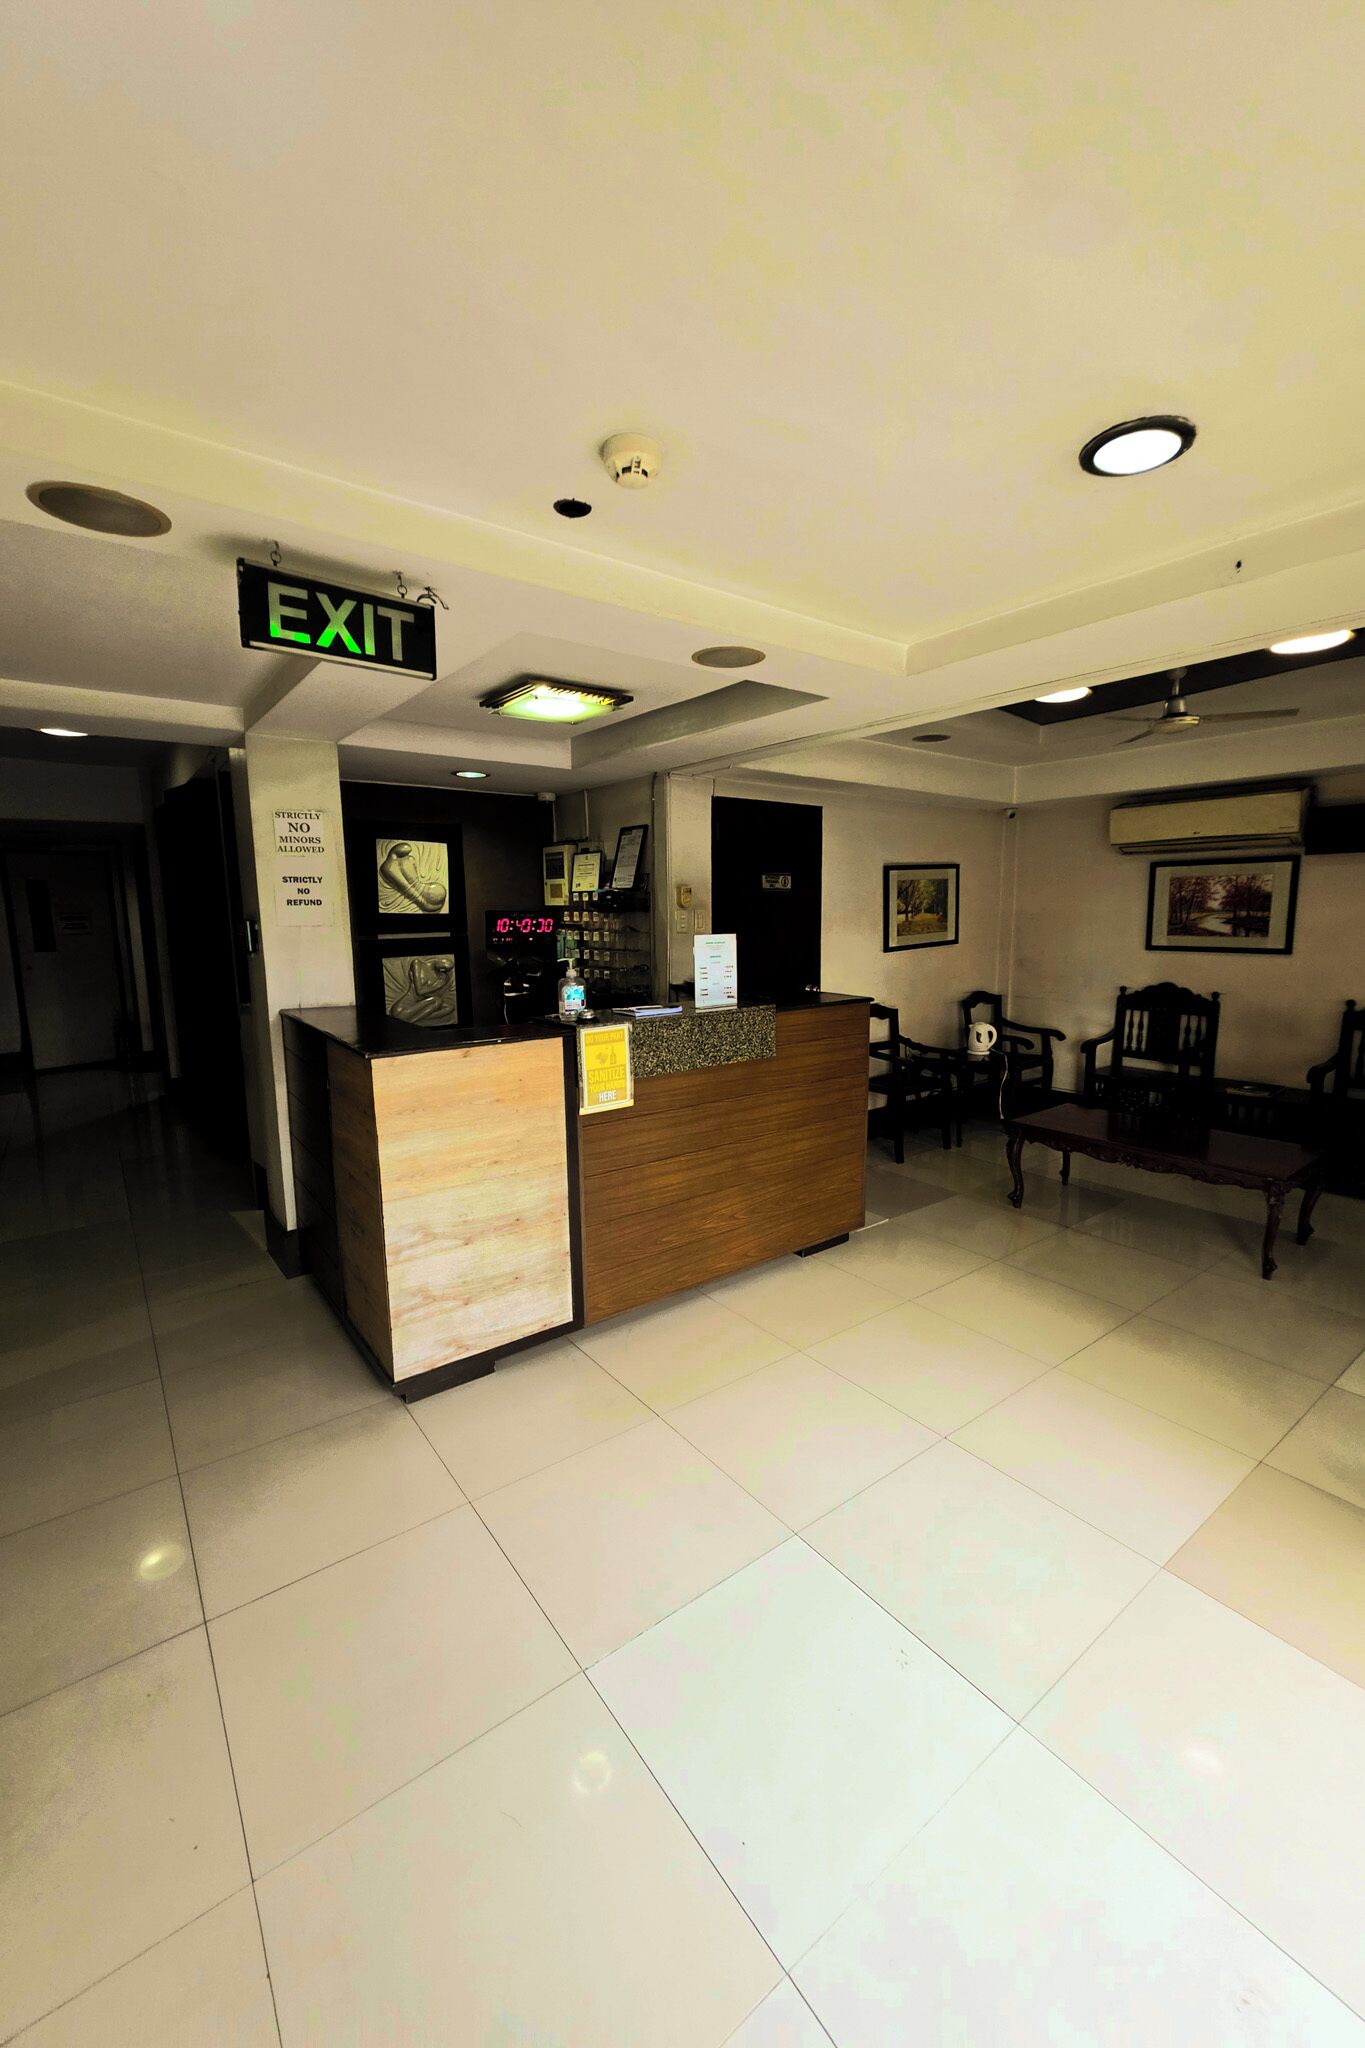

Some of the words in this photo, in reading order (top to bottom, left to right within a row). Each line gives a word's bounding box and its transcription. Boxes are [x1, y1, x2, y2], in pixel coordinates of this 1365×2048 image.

[268, 581, 415, 662] EXIT
[274, 811, 321, 820] STRICTLY
[288, 822, 311, 833] NO
[279, 835, 321, 844] MINORS
[277, 845, 325, 853] ALLOWED
[282, 876, 323, 884] STRICTLY
[588, 1066, 625, 1083] SANITIZE
[598, 1090, 617, 1102] HERE
